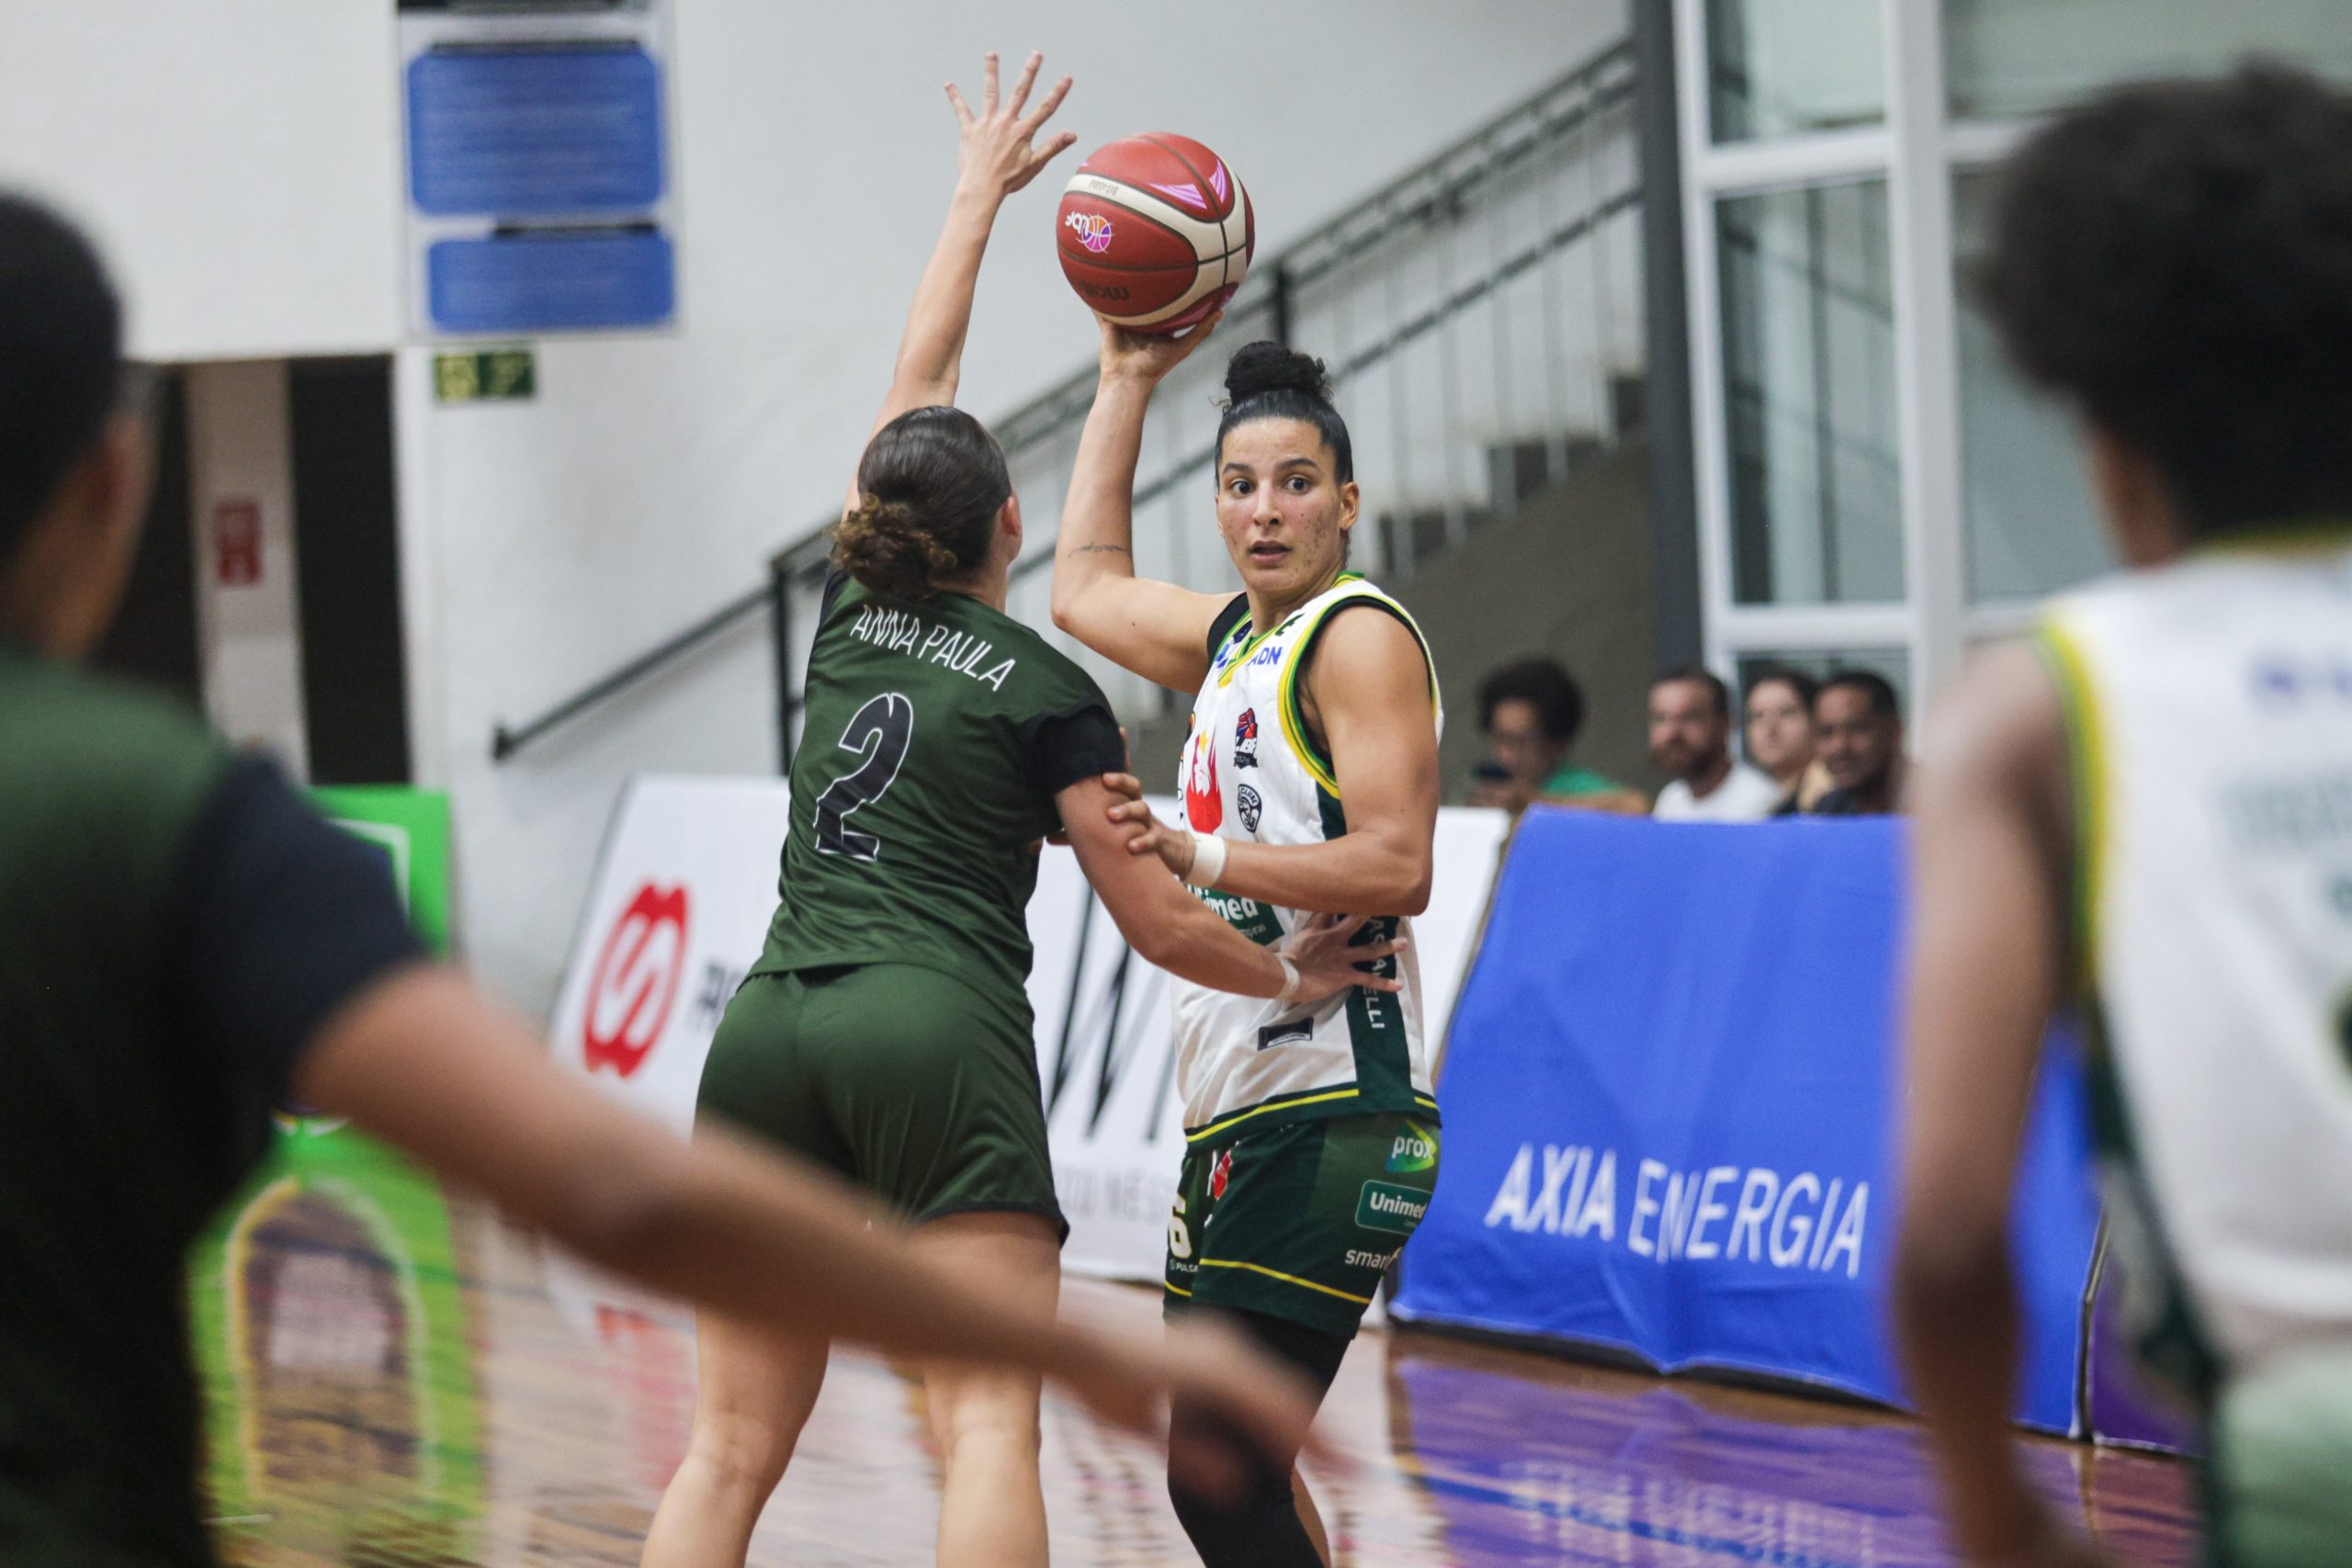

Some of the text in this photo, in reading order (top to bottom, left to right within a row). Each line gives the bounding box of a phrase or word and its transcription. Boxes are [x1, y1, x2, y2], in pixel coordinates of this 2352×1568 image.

[850, 604, 1016, 692] ANNA PAULA
[813, 692, 913, 862] 2
[1483, 1140, 1870, 1280] AXIA ENERGIA
